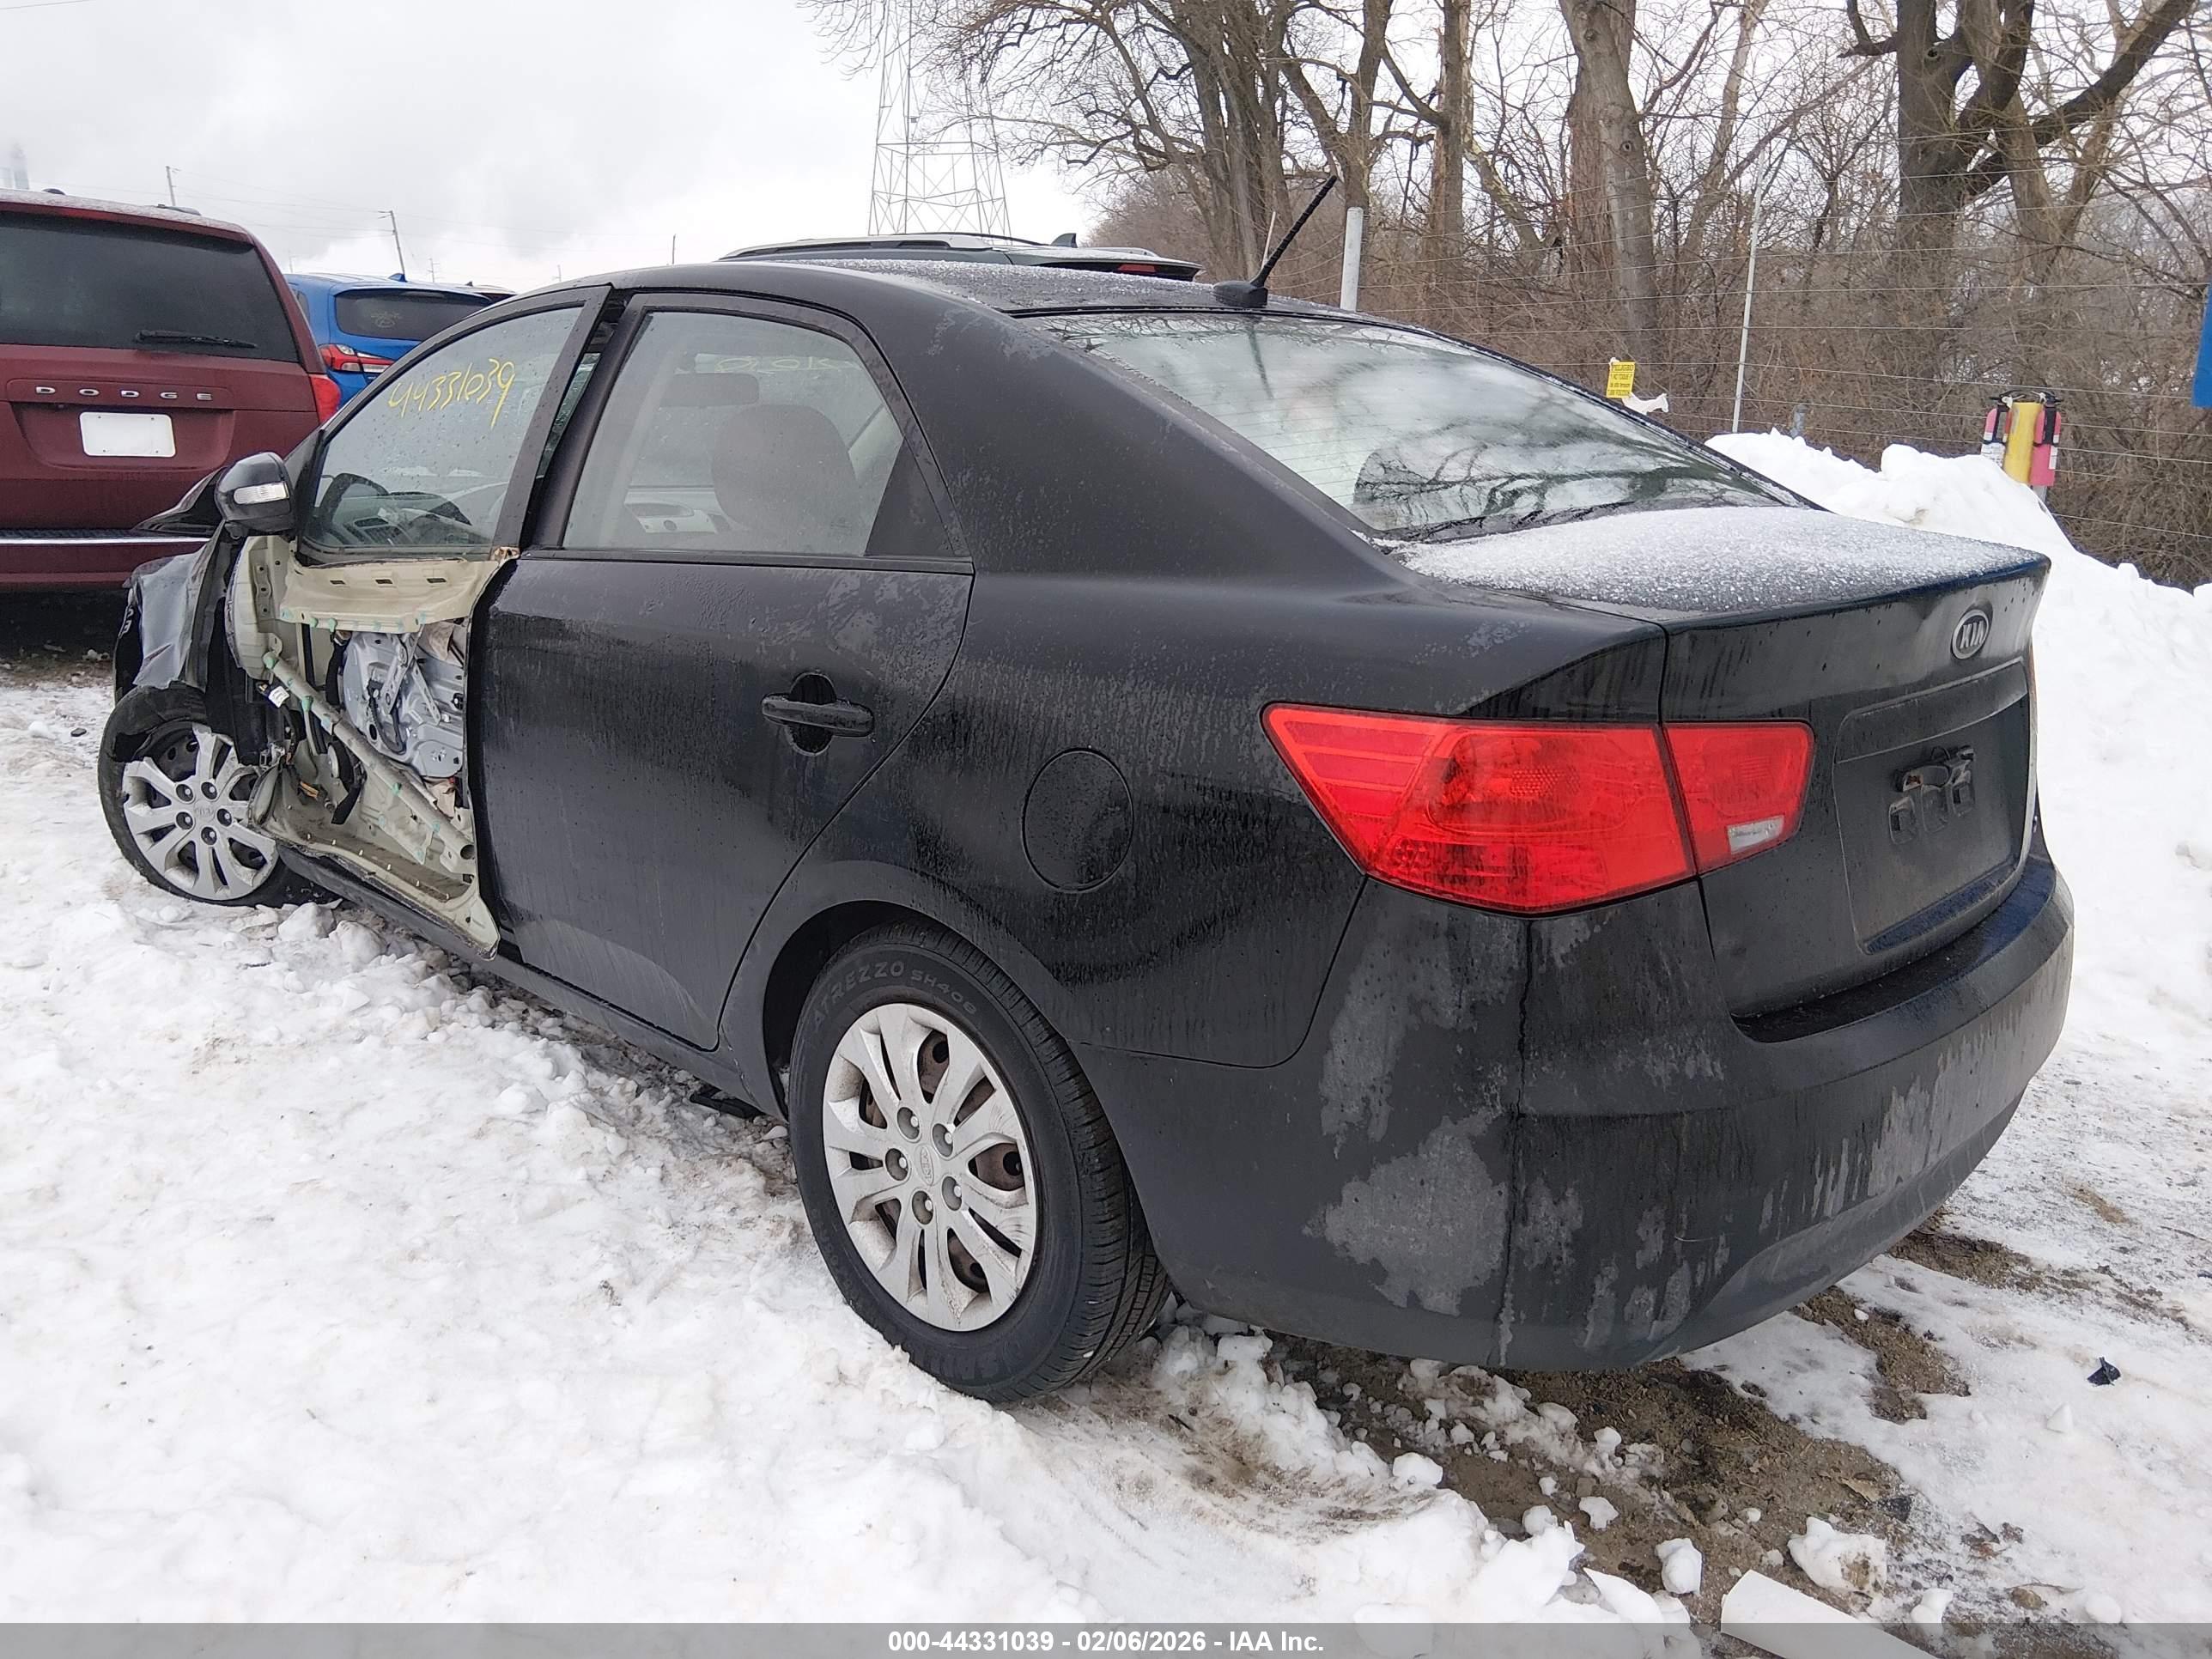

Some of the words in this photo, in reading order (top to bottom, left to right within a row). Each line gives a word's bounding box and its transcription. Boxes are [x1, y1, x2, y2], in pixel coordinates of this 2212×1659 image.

[35, 386, 213, 401] DODGE
[388, 358, 515, 430] 44331039
[1960, 620, 1985, 649] KIA
